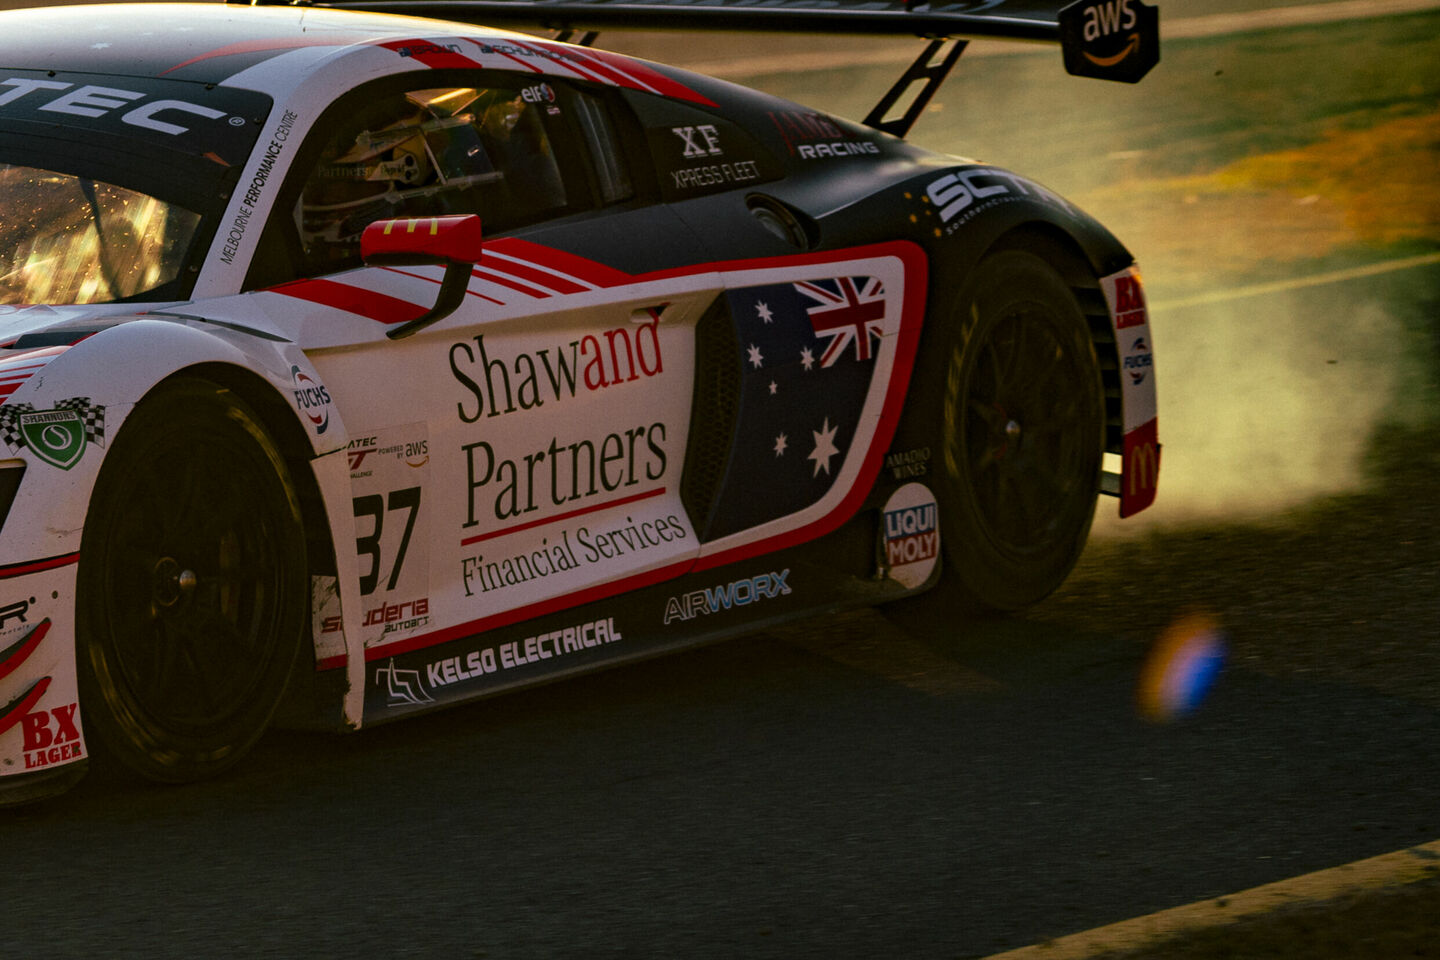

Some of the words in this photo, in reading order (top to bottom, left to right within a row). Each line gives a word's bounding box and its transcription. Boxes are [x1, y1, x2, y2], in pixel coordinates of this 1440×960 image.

[521, 85, 542, 103] elf
[672, 125, 723, 158] XF
[797, 141, 880, 159] RACING
[220, 206, 253, 265] MELBOURNE
[243, 140, 283, 208] PERFORMANCE
[274, 108, 298, 142] CENTRE
[670, 165, 724, 189] XPRESS
[721, 160, 760, 182] FLEET
[294, 385, 331, 410] FUCHS
[23, 410, 76, 423] SHANNONS
[348, 436, 377, 449] ATEC
[406, 440, 427, 457] aws
[461, 422, 667, 528] Partners
[887, 505, 934, 537] LIQUI
[461, 530, 579, 597] Financial
[583, 512, 687, 563] Services
[889, 532, 935, 566] MOLY
[664, 570, 792, 624] AIRWORX
[427, 648, 497, 688] KELSO
[501, 618, 622, 669] ELECTRICAL
[21, 703, 80, 751] BX
[24, 741, 82, 769] LAGER
